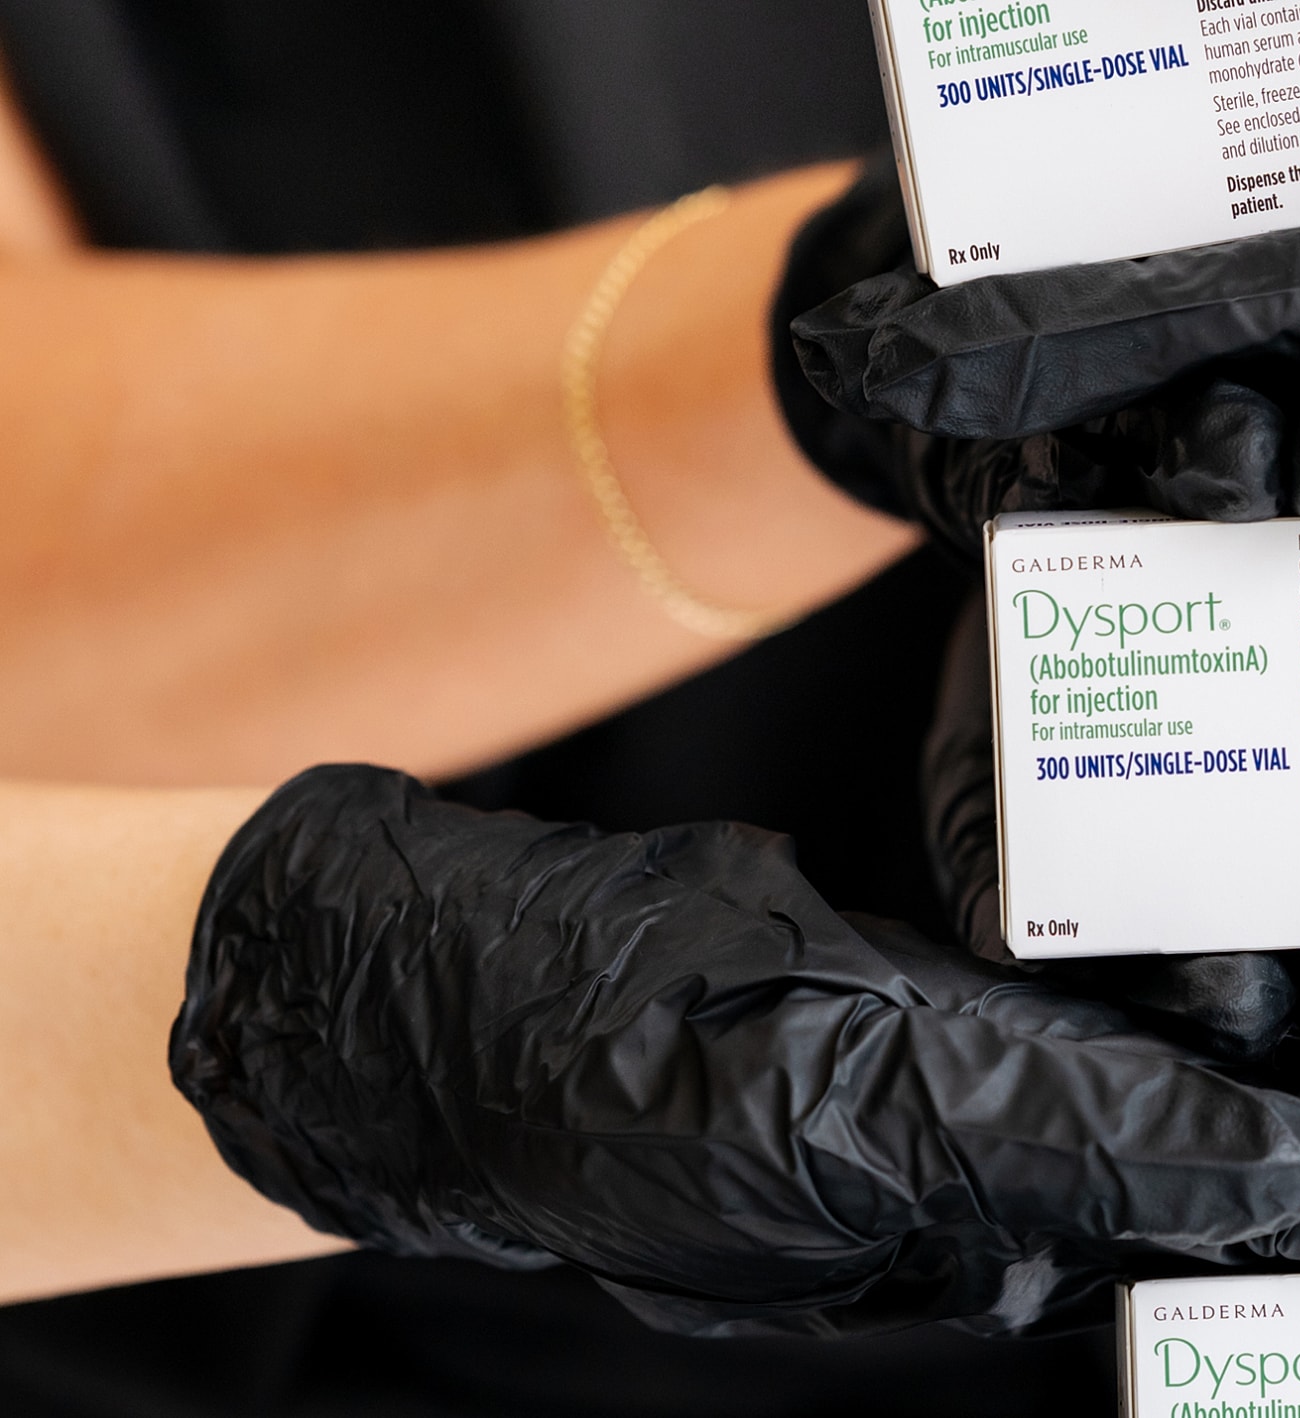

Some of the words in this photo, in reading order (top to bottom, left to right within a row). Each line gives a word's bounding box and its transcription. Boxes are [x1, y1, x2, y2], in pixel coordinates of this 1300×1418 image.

[923, 17, 952, 43] for
[958, 2, 1050, 39] injection
[928, 50, 951, 69] For
[956, 32, 1057, 64] intramuscular
[1062, 29, 1088, 46] use
[1204, 41, 1250, 60] human
[1253, 34, 1294, 52] serum
[937, 81, 971, 108] 300
[975, 50, 1147, 101] UNITS/SINGLE-DOSE
[1149, 44, 1189, 71] VIAL
[1209, 56, 1295, 84] monohydrate
[1213, 91, 1258, 112] Sterile,
[1217, 119, 1240, 136] See
[1244, 107, 1300, 131] enclosed
[1222, 140, 1246, 160] and
[1250, 134, 1299, 155] dilution
[1227, 171, 1286, 192] Dispense
[1231, 194, 1283, 219] patient.
[948, 249, 967, 265] Rx
[970, 242, 999, 261] Only
[1012, 555, 1142, 573] GALDERMA
[1030, 645, 1267, 684] (AbobotulinumtoxinA)
[1031, 689, 1060, 715] for
[1067, 685, 1157, 717] injection
[1032, 723, 1055, 741] For
[1060, 718, 1163, 740] intramuscular
[1168, 721, 1192, 735] use
[1036, 756, 1069, 781] 300
[1075, 749, 1247, 780] UNITS/SINGLE-DOSE
[1252, 747, 1290, 771] VIAL
[1027, 921, 1044, 937] Rx
[1048, 919, 1079, 938] Only
[1154, 1304, 1284, 1321] GALDERMA
